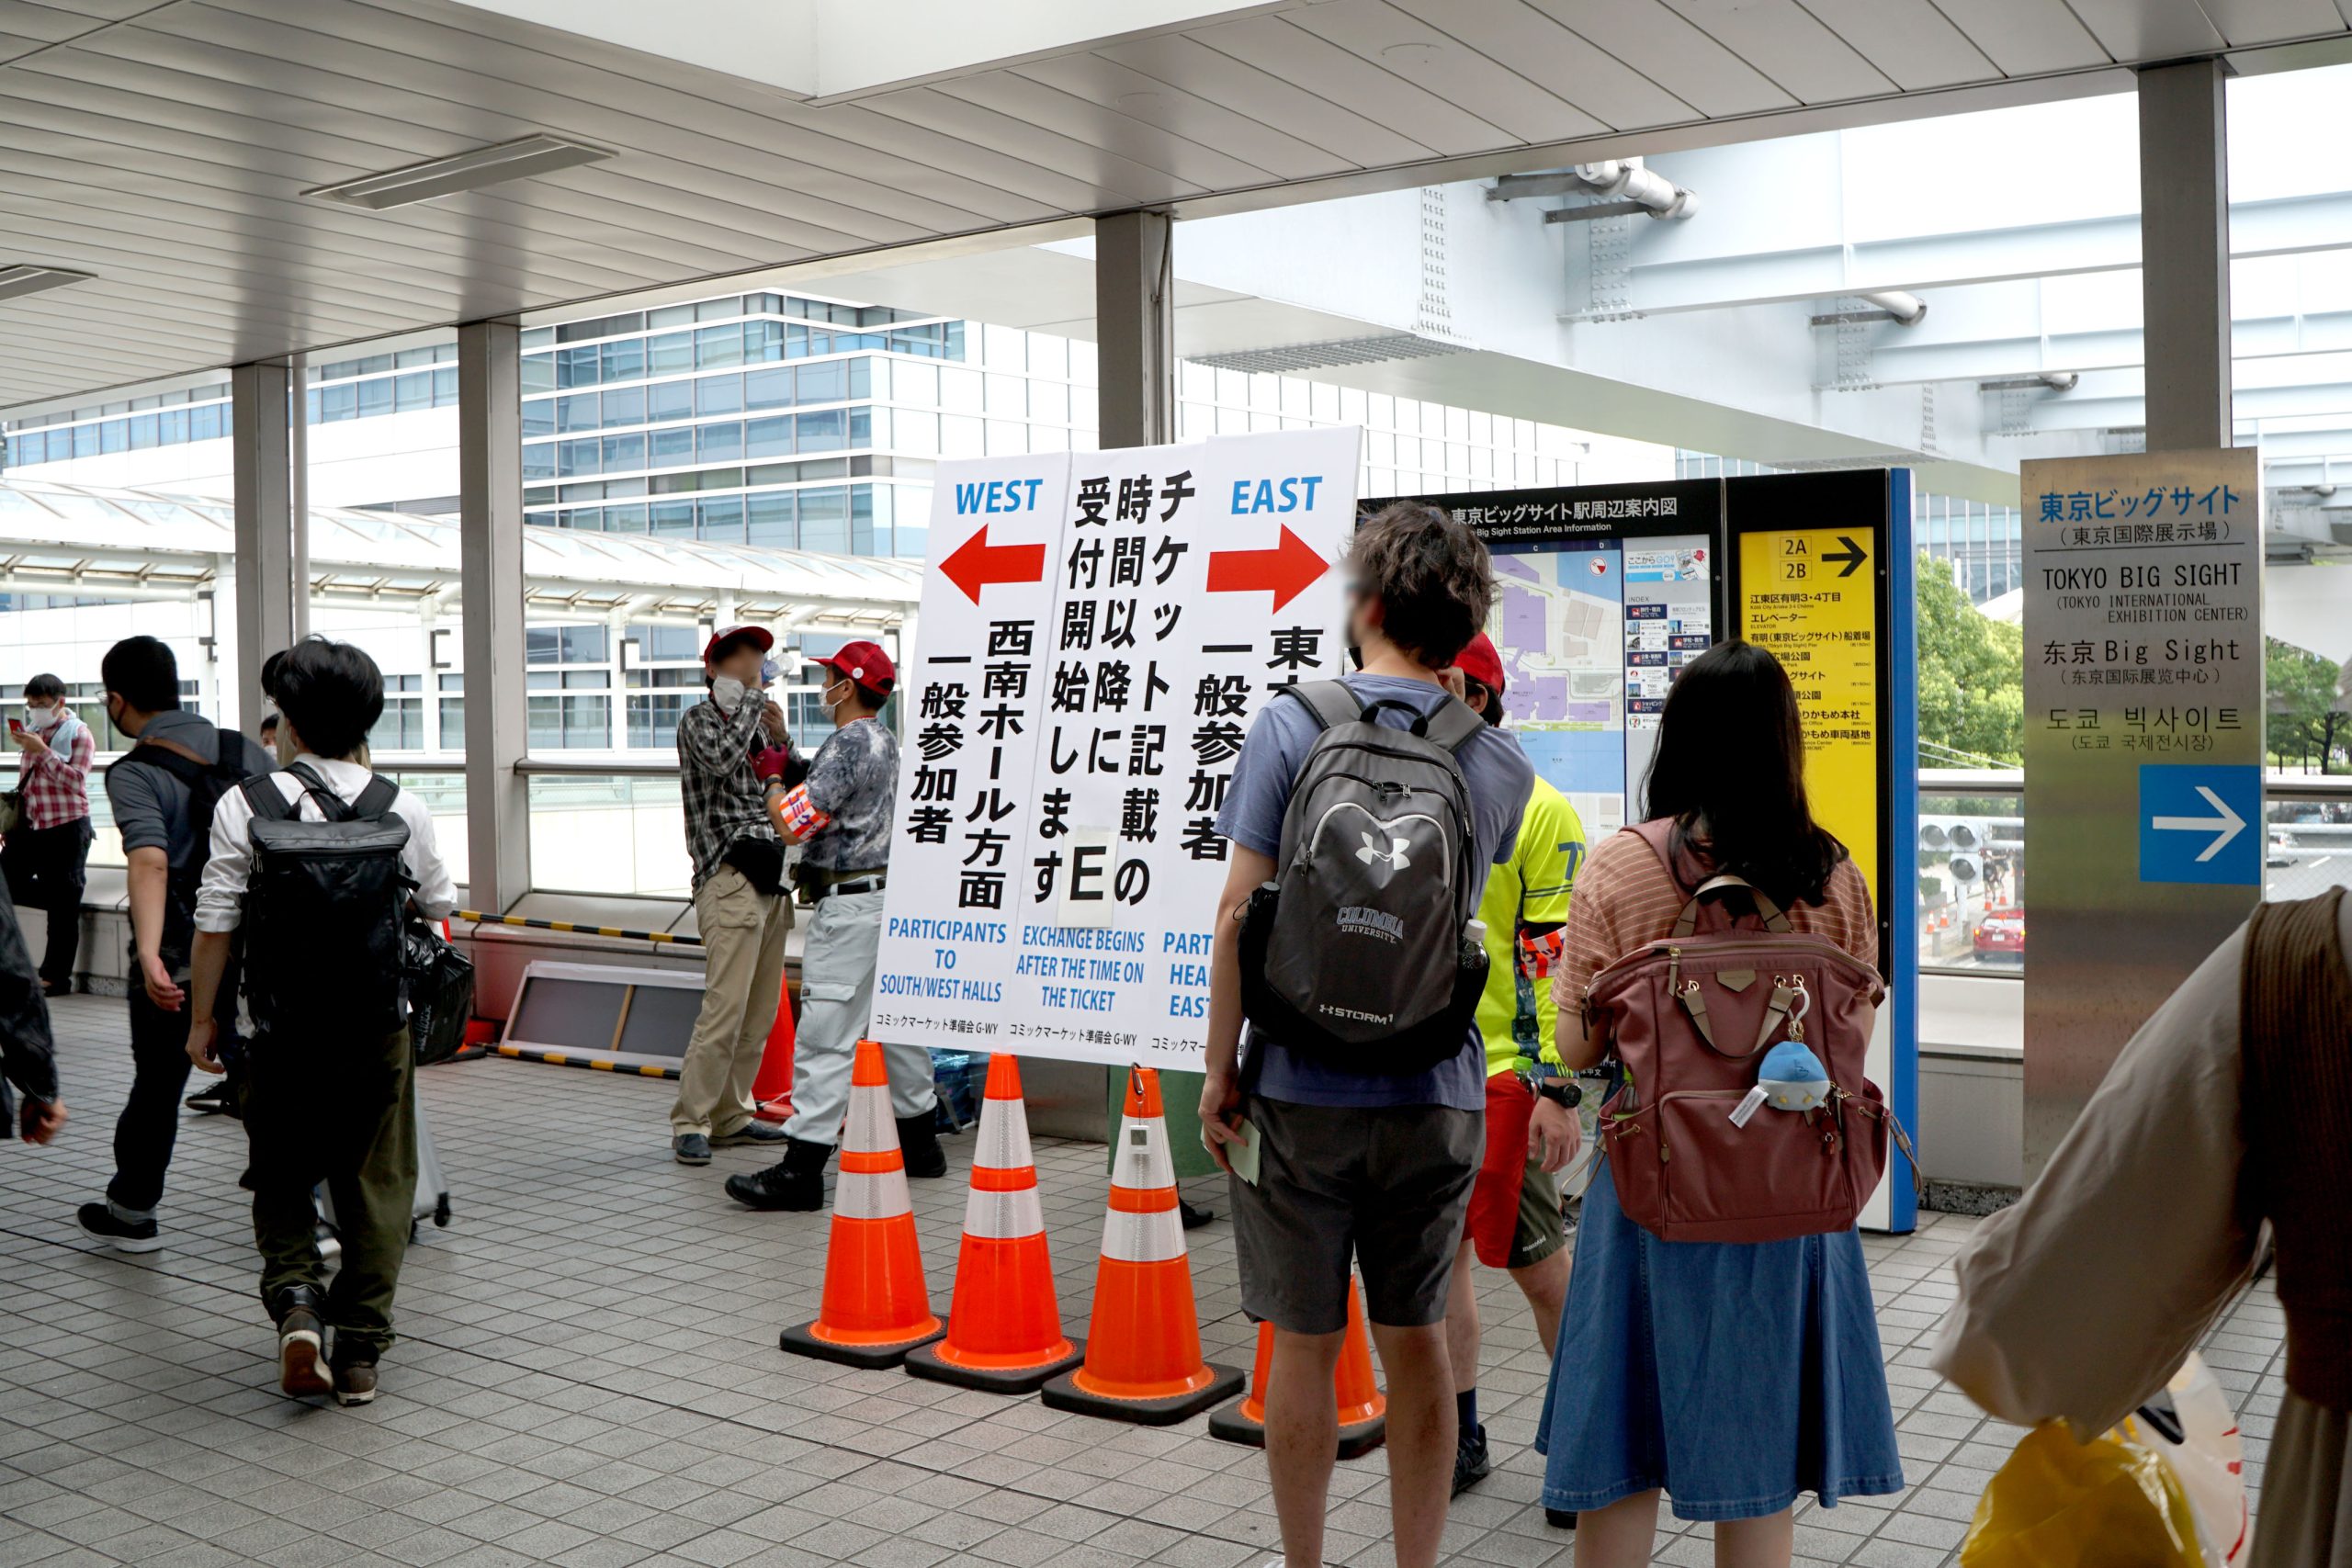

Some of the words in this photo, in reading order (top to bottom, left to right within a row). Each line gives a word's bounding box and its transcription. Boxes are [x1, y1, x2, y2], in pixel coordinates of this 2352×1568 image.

[956, 478, 1044, 515] WEST
[1230, 476, 1323, 515] EAST
[2039, 485, 2240, 524] 東京ビッグサイト
[1451, 497, 1678, 526] 東京ビッグサイト駅周辺案内図
[1476, 526, 1489, 538] Big
[1491, 525, 1511, 537] Sight
[1513, 525, 1542, 535] Station
[1544, 524, 1562, 534] Area
[1564, 522, 1612, 533] Information
[2060, 521, 2230, 546] （東京国際展示場）
[1785, 539, 1807, 555] 2A
[1786, 563, 1806, 579] 2B
[2042, 567, 2108, 591] TOKYO
[2120, 566, 2160, 588] BIG
[2174, 563, 2242, 587] SIGHT
[2057, 595, 2100, 611] (TOKYO
[2109, 592, 2211, 608] INTERNATIONAL
[1089, 474, 1153, 773] 時間以降に
[1751, 614, 1808, 623] エレベーター
[2108, 609, 2187, 624] EXHIBITION
[2194, 607, 2249, 623] CENTER)
[2165, 638, 2240, 664] Sight
[1114, 470, 1195, 906] チケット記載の
[1790, 671, 1826, 681] グサイト
[1034, 476, 1110, 904] 受付開始します
[1801, 710, 1860, 720] りかもめ本社
[2046, 708, 2101, 730] 도쿄
[2124, 705, 2242, 734] 빅사이트
[1803, 729, 1871, 740] かもめ車両基地
[2072, 734, 2111, 750] (도쿄
[907, 656, 971, 844] 一般参加者
[1180, 644, 1253, 862] 一般参加者
[958, 620, 1035, 909] 西南ホール方面
[1069, 845, 1107, 900] E
[888, 917, 1007, 944] PARTICIPANTS
[1336, 906, 1404, 940] COLUMBIA
[1341, 924, 1396, 944] UNIVERSITY
[1023, 925, 1093, 950] EXCHANGE
[1095, 928, 1146, 953] BEGINS
[1162, 931, 1214, 956] PART
[934, 949, 957, 970] TO
[1015, 954, 1057, 978] AFTER
[1060, 956, 1086, 980] THE
[1089, 959, 1122, 983] TIME
[1123, 962, 1145, 984] ON
[1170, 963, 1213, 987] HEA
[879, 974, 960, 1000] SOUTH/WEST
[961, 979, 1002, 1003] HALLS
[1041, 986, 1067, 1009] THE
[1069, 987, 1115, 1012] TICKET
[976, 1021, 999, 1035] G-WY
[1114, 1032, 1137, 1046] G-WY
[1150, 1037, 1206, 1053] コミックマー
